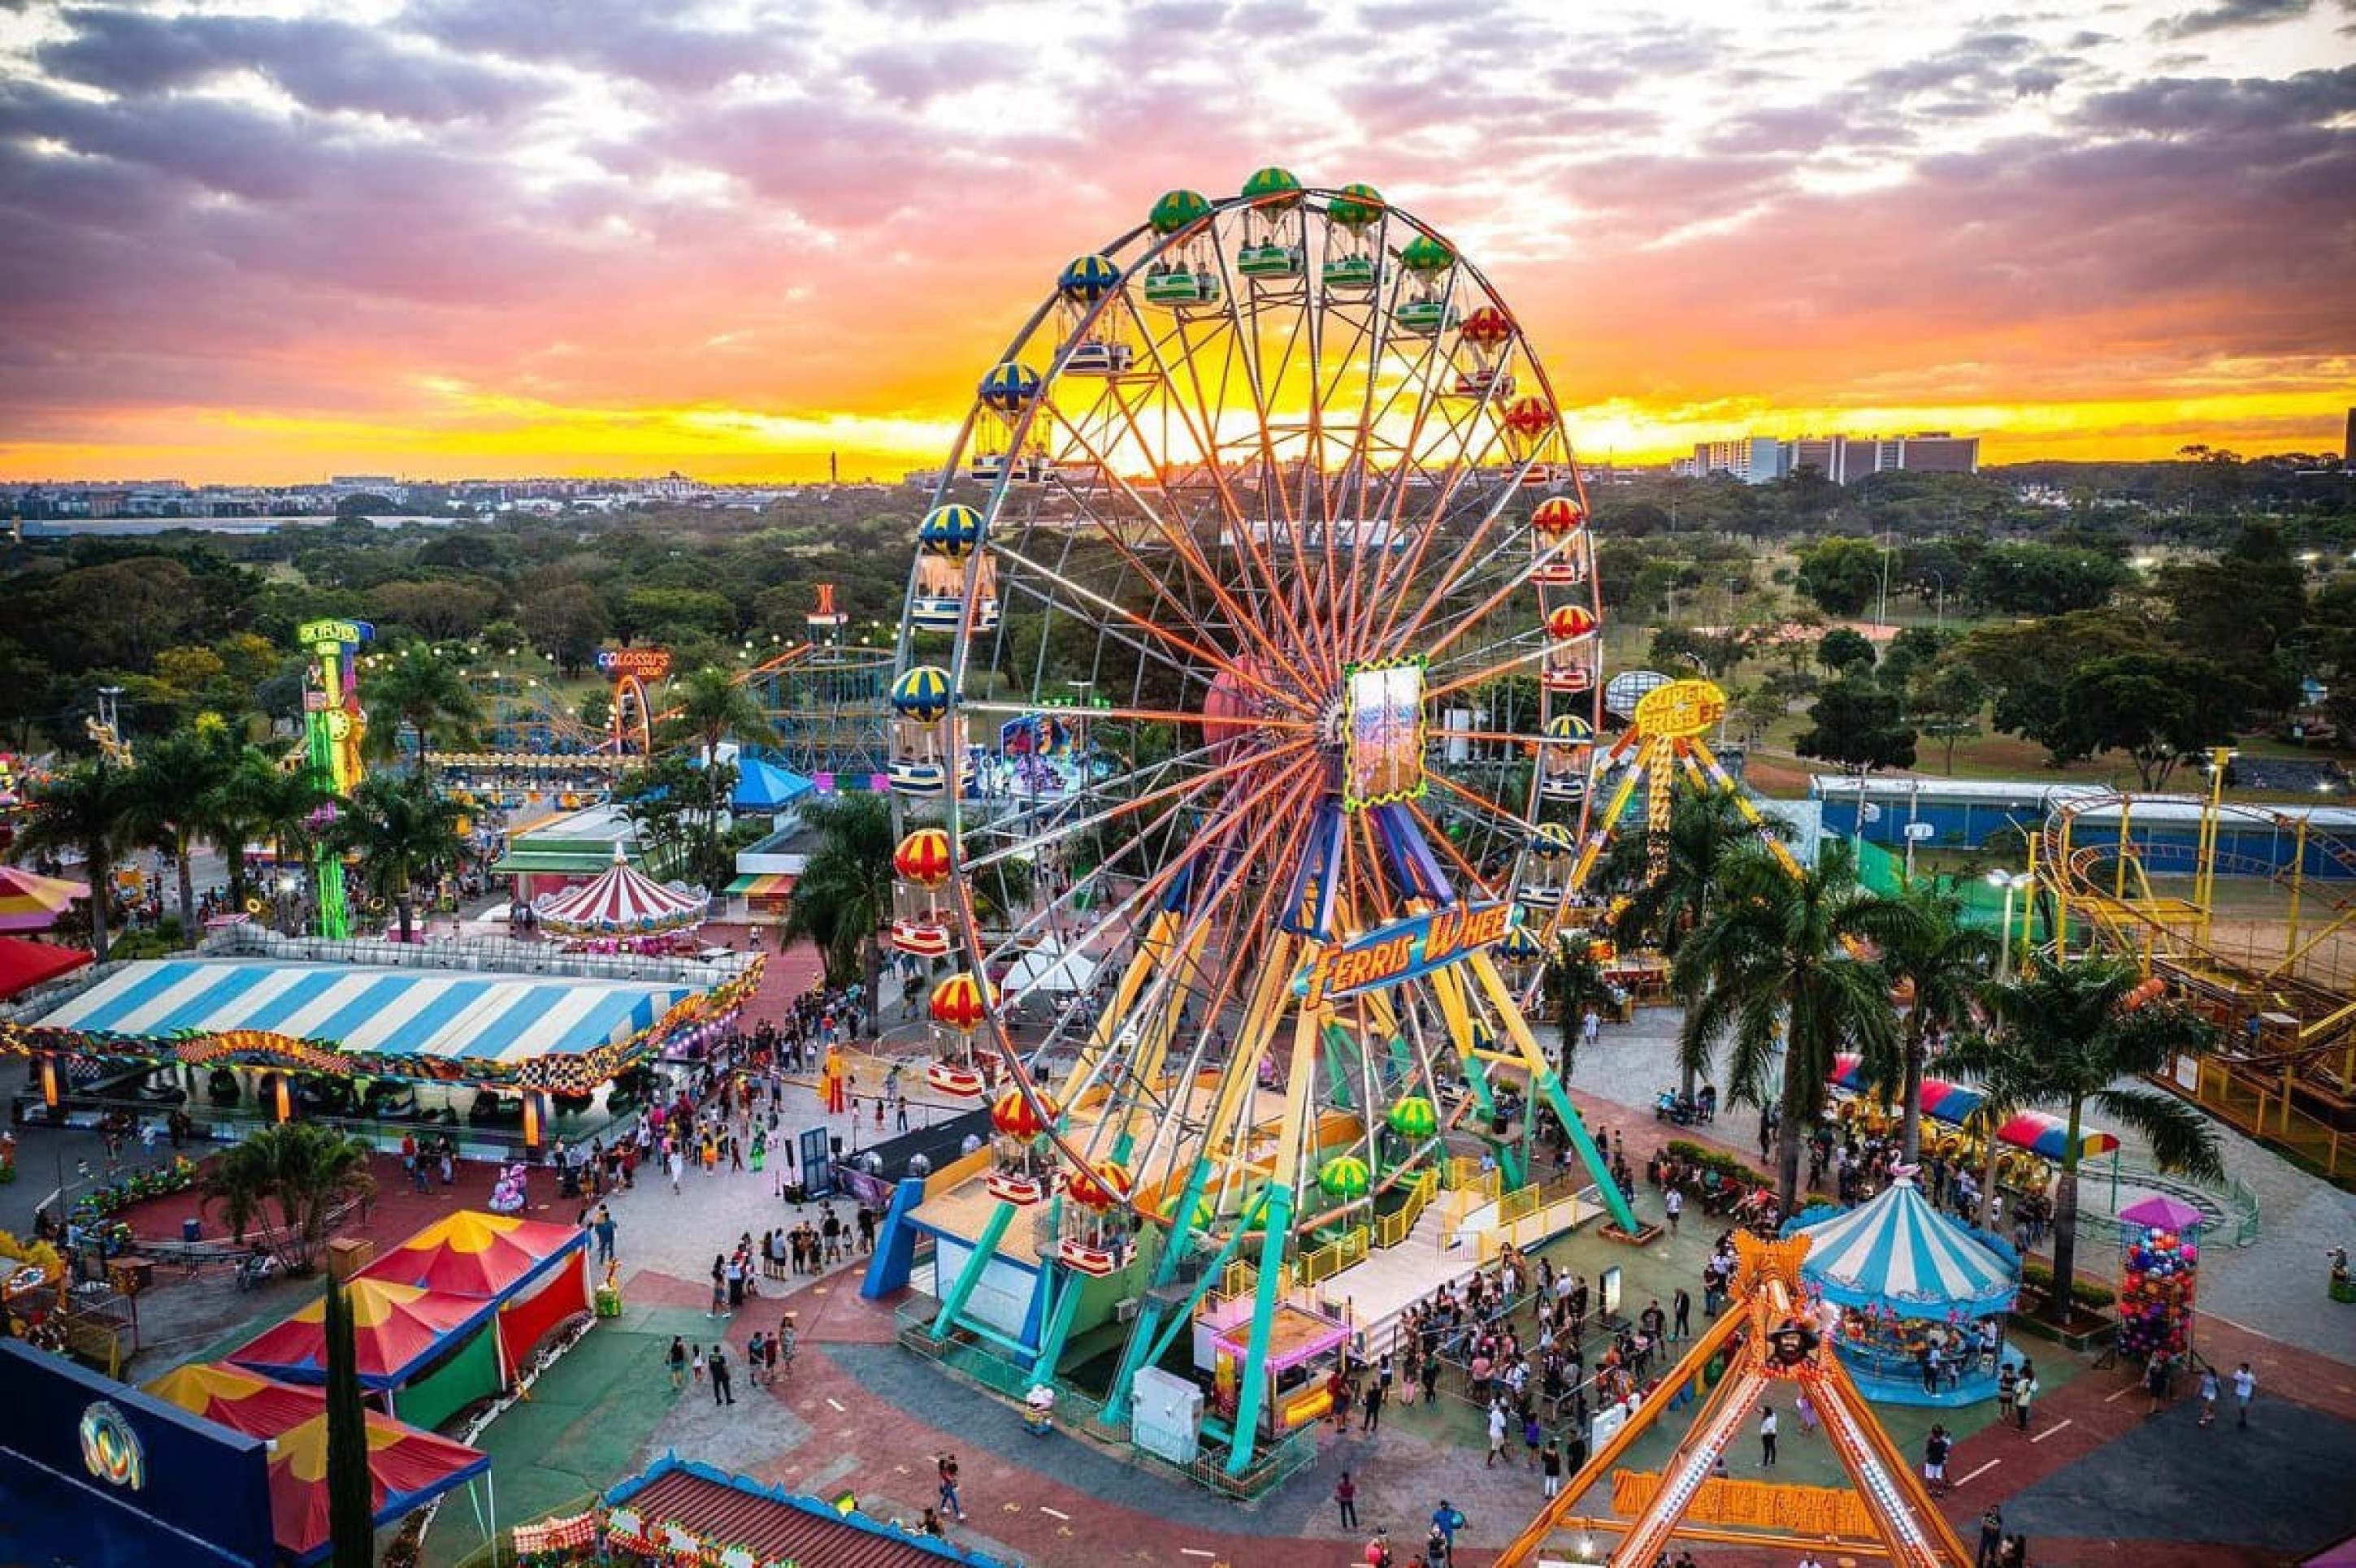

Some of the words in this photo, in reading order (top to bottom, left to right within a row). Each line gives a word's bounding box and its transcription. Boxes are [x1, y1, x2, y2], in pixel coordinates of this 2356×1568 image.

[598, 652, 670, 666] COLOSSUS
[1645, 684, 1708, 711] SUPER
[1639, 703, 1724, 737] FRISBEE
[1305, 934, 1414, 1010] FERRIS
[1425, 899, 1510, 961] WHEE
